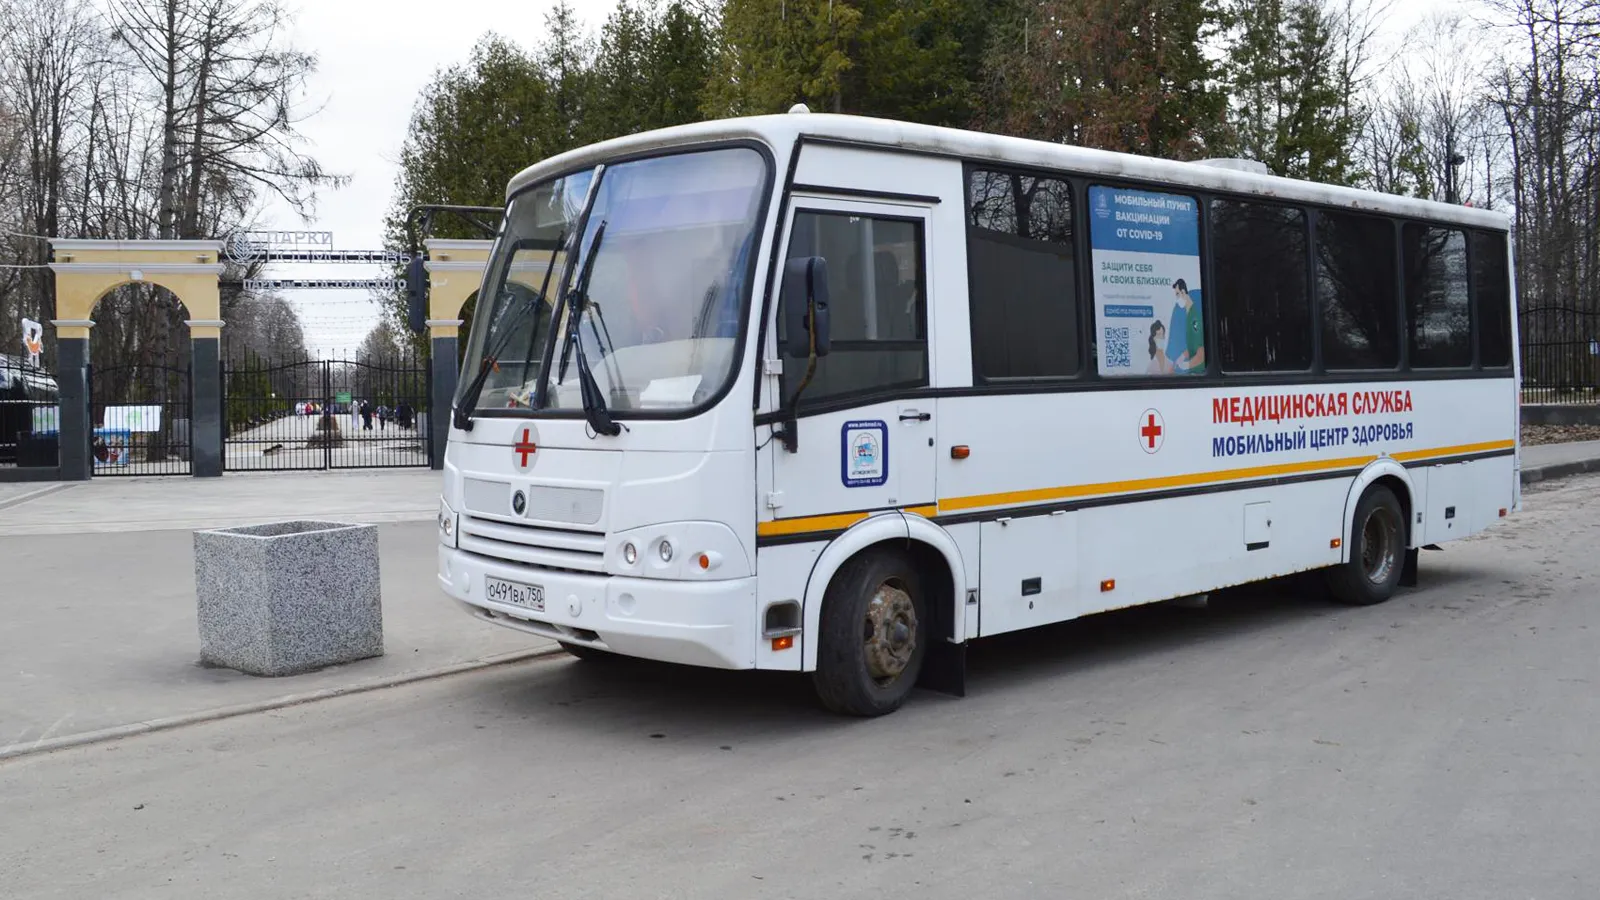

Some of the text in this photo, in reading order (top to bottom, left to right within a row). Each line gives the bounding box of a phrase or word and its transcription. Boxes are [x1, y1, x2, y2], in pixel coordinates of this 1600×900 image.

[1114, 194, 1191, 211] МОБИЛЬНЫЙ ПУНКТ
[1115, 211, 1170, 225] ВАКЦИНАЦИИ
[267, 231, 333, 245] ПАРКИ
[1116, 228, 1163, 241] ОТ COVID-19
[1101, 262, 1153, 273] ЗАЩИТИ СЕБЯ
[243, 278, 275, 289] ПАРК
[1102, 275, 1172, 287] И СВОИХ БЛИЗКИХ!
[1212, 389, 1413, 427] МЕДИЦИНСКАЯ СЛУЖБА
[1212, 422, 1413, 458] МОБИЛЬНЫЙ ЦЕНТР ЗДОРОВЬЯ
[526, 587, 542, 602] 750
